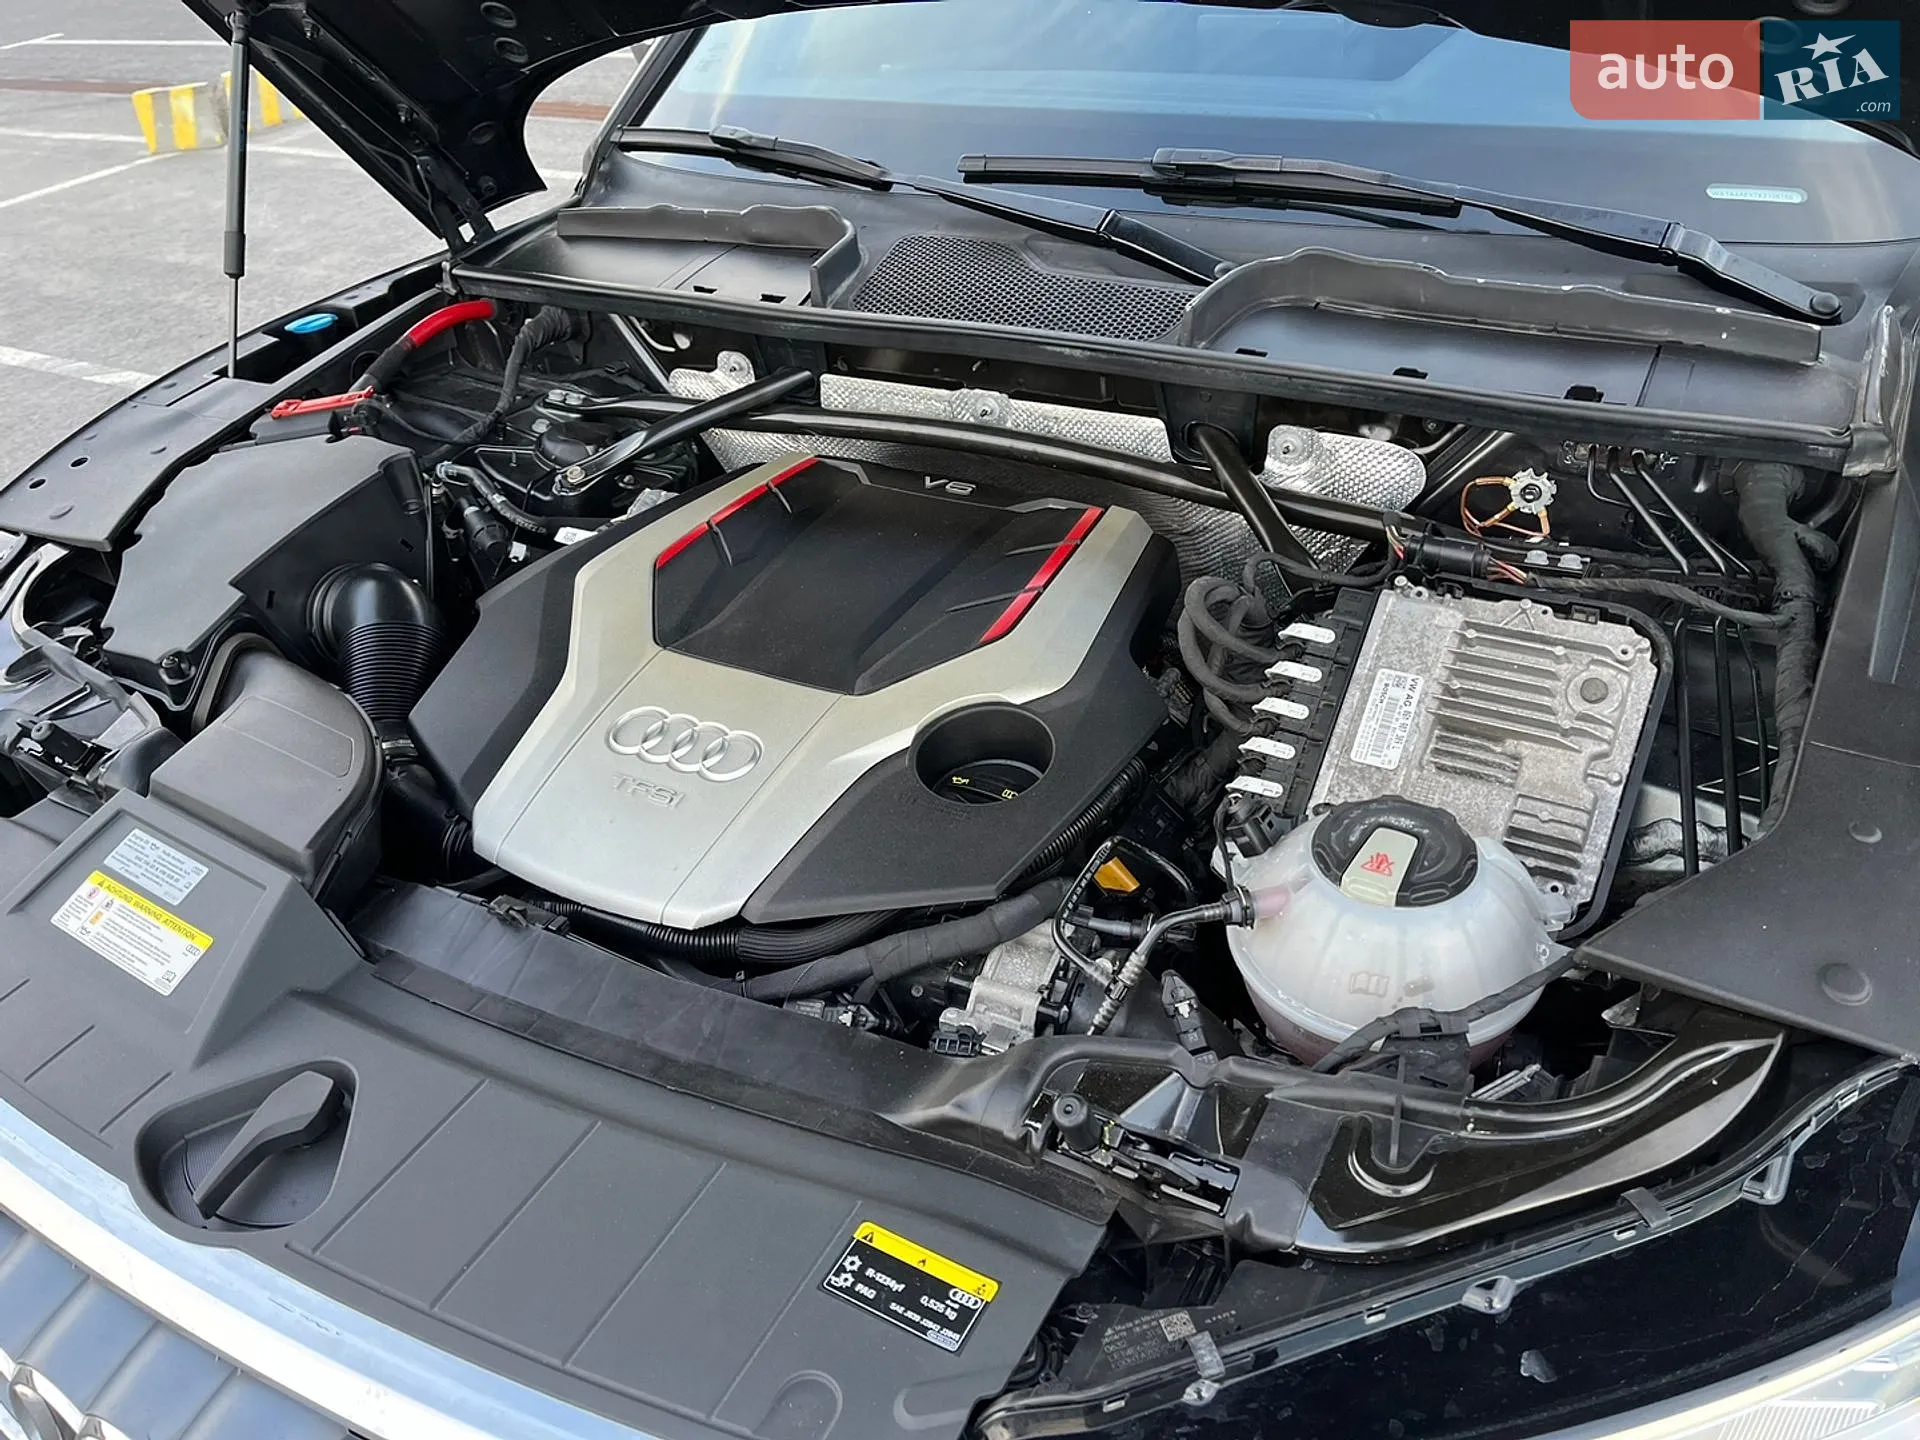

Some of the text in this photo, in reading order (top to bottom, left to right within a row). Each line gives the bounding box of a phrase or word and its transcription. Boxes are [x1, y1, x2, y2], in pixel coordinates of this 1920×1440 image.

[924, 475, 976, 496] V6
[1408, 677, 1419, 693] VW
[1402, 693, 1413, 707] AG
[612, 773, 686, 810] TFSI
[162, 917, 197, 941] ATTENTION
[854, 1283, 877, 1299] PAG
[864, 1267, 906, 1293] R-1234yf
[919, 1295, 958, 1321] 0,525 kg
